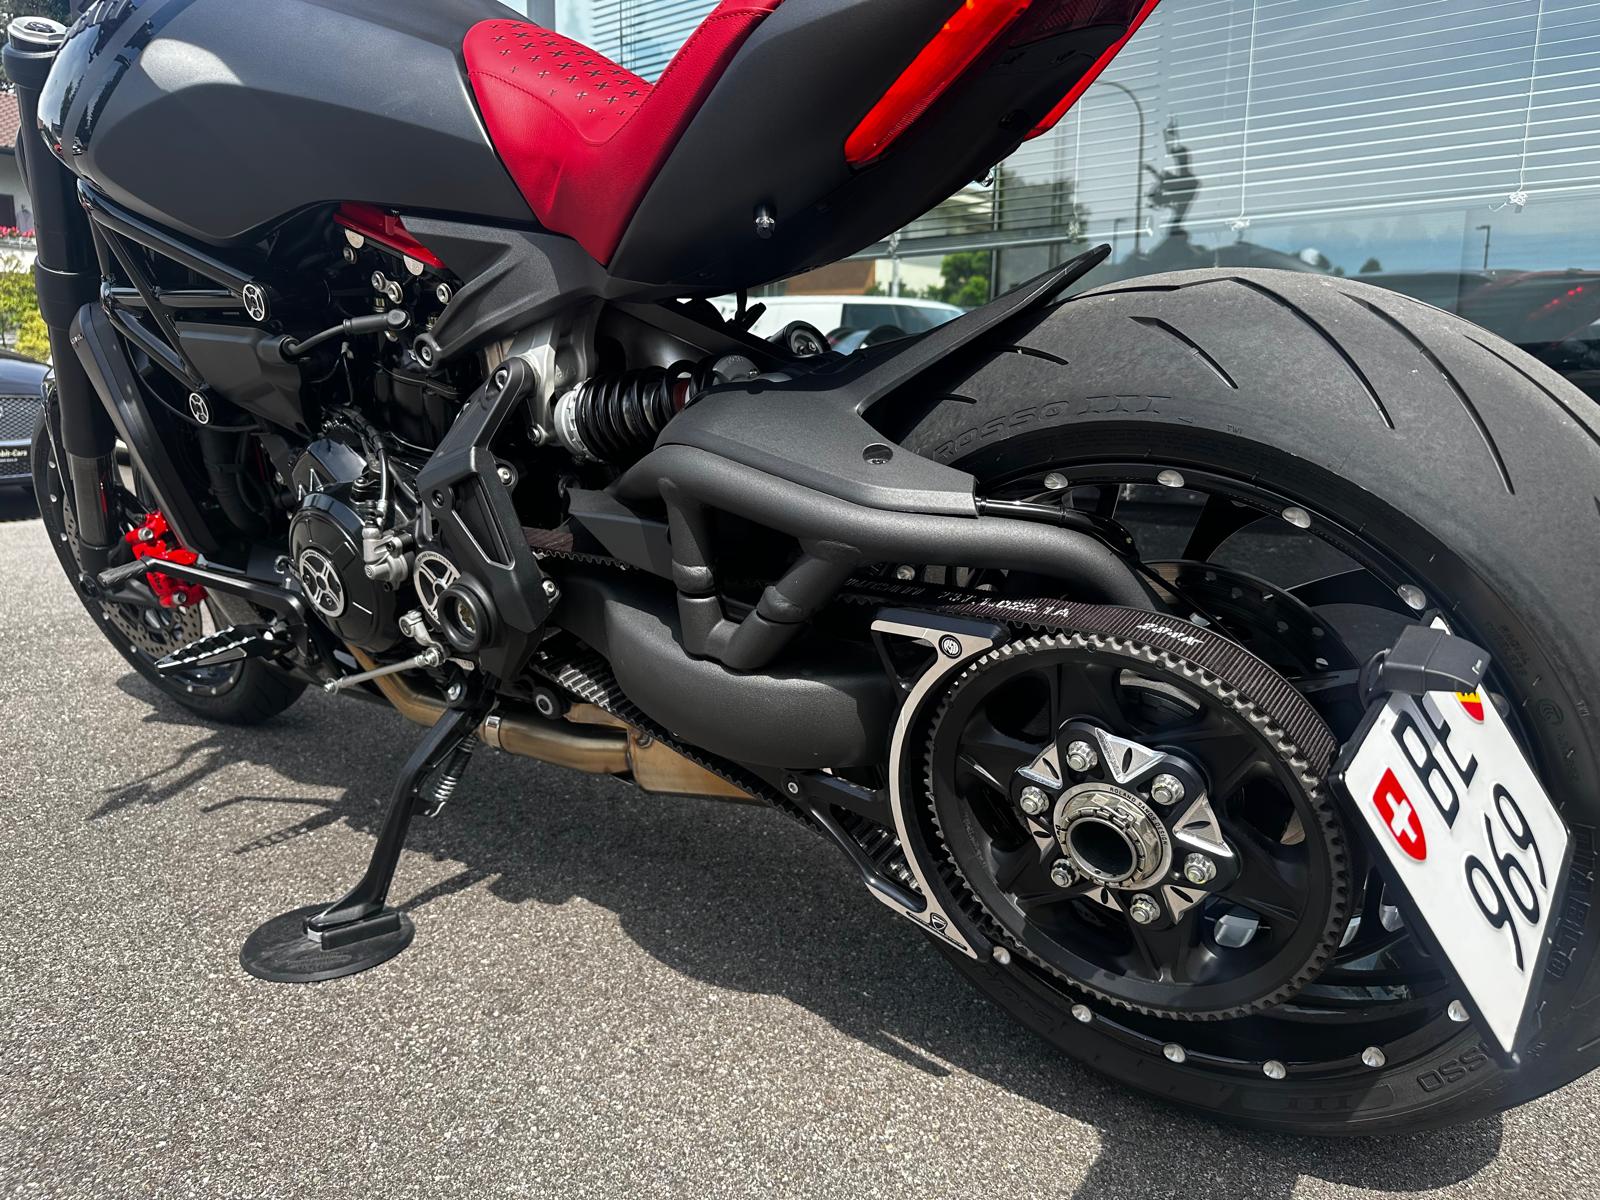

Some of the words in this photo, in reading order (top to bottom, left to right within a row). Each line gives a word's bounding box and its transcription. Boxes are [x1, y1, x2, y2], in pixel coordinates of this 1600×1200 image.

[932, 400, 1070, 464] ROSSO
[1391, 694, 1479, 830] BE
[1109, 786, 1137, 802] ROLAND
[1137, 801, 1157, 823] SANDS
[1155, 822, 1169, 846] DESIGN
[1464, 782, 1548, 972] 969
[1417, 1045, 1490, 1092] SSO
